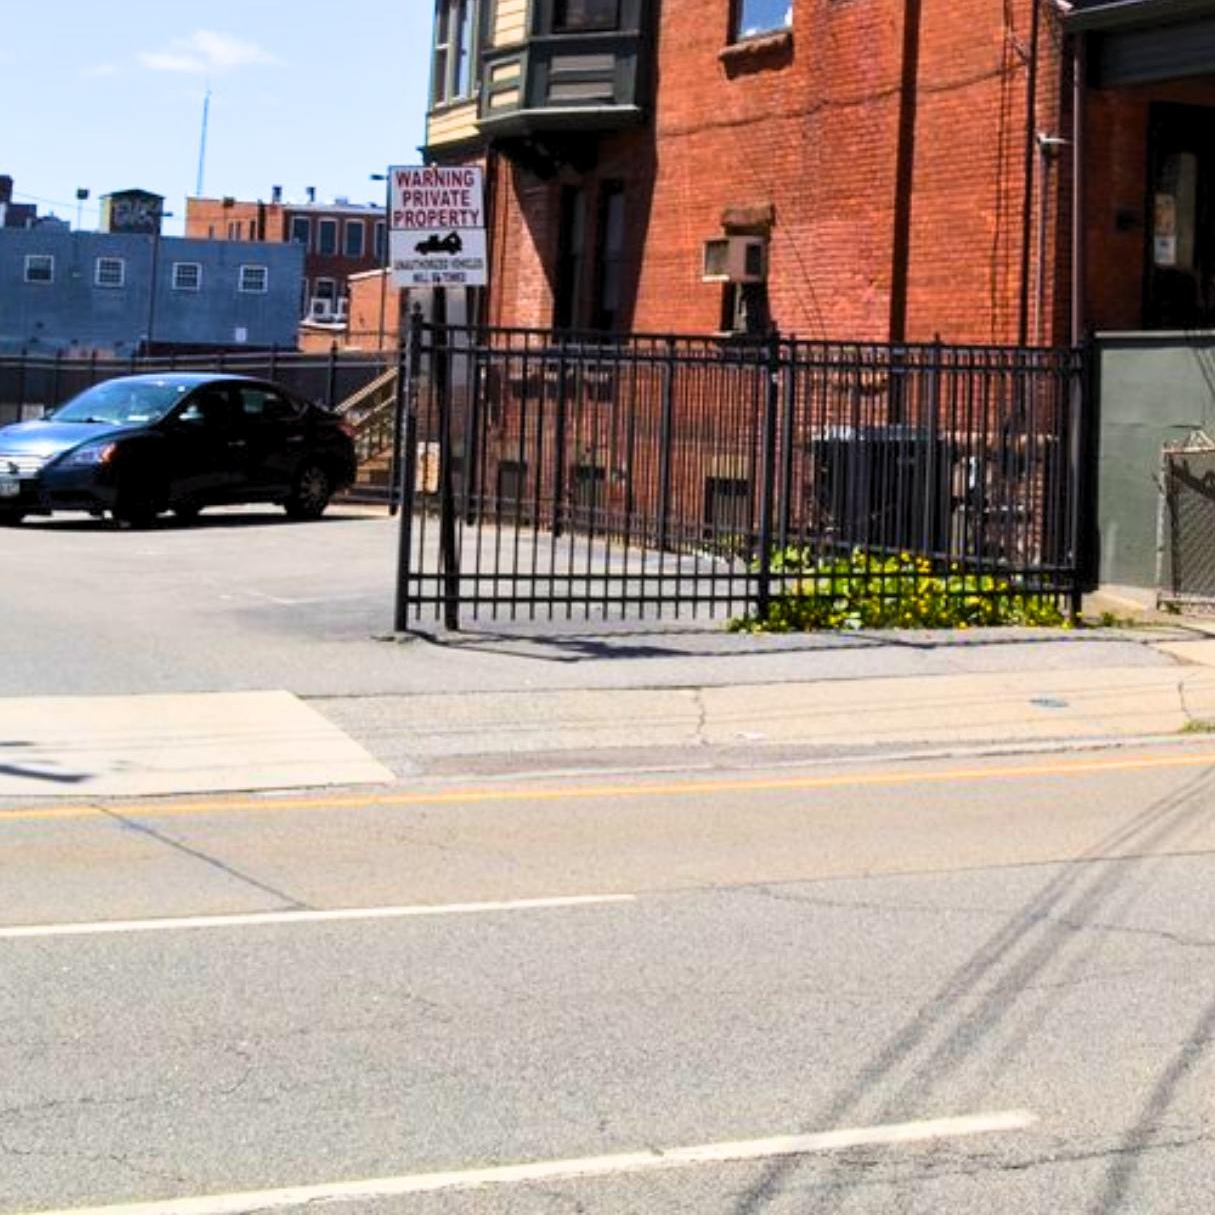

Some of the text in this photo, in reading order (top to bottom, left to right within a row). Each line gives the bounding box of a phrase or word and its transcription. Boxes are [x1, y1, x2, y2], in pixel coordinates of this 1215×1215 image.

[395, 170, 475, 187] WARNING
[402, 189, 471, 207] PRIVATE
[393, 209, 480, 228] PROPERTY
